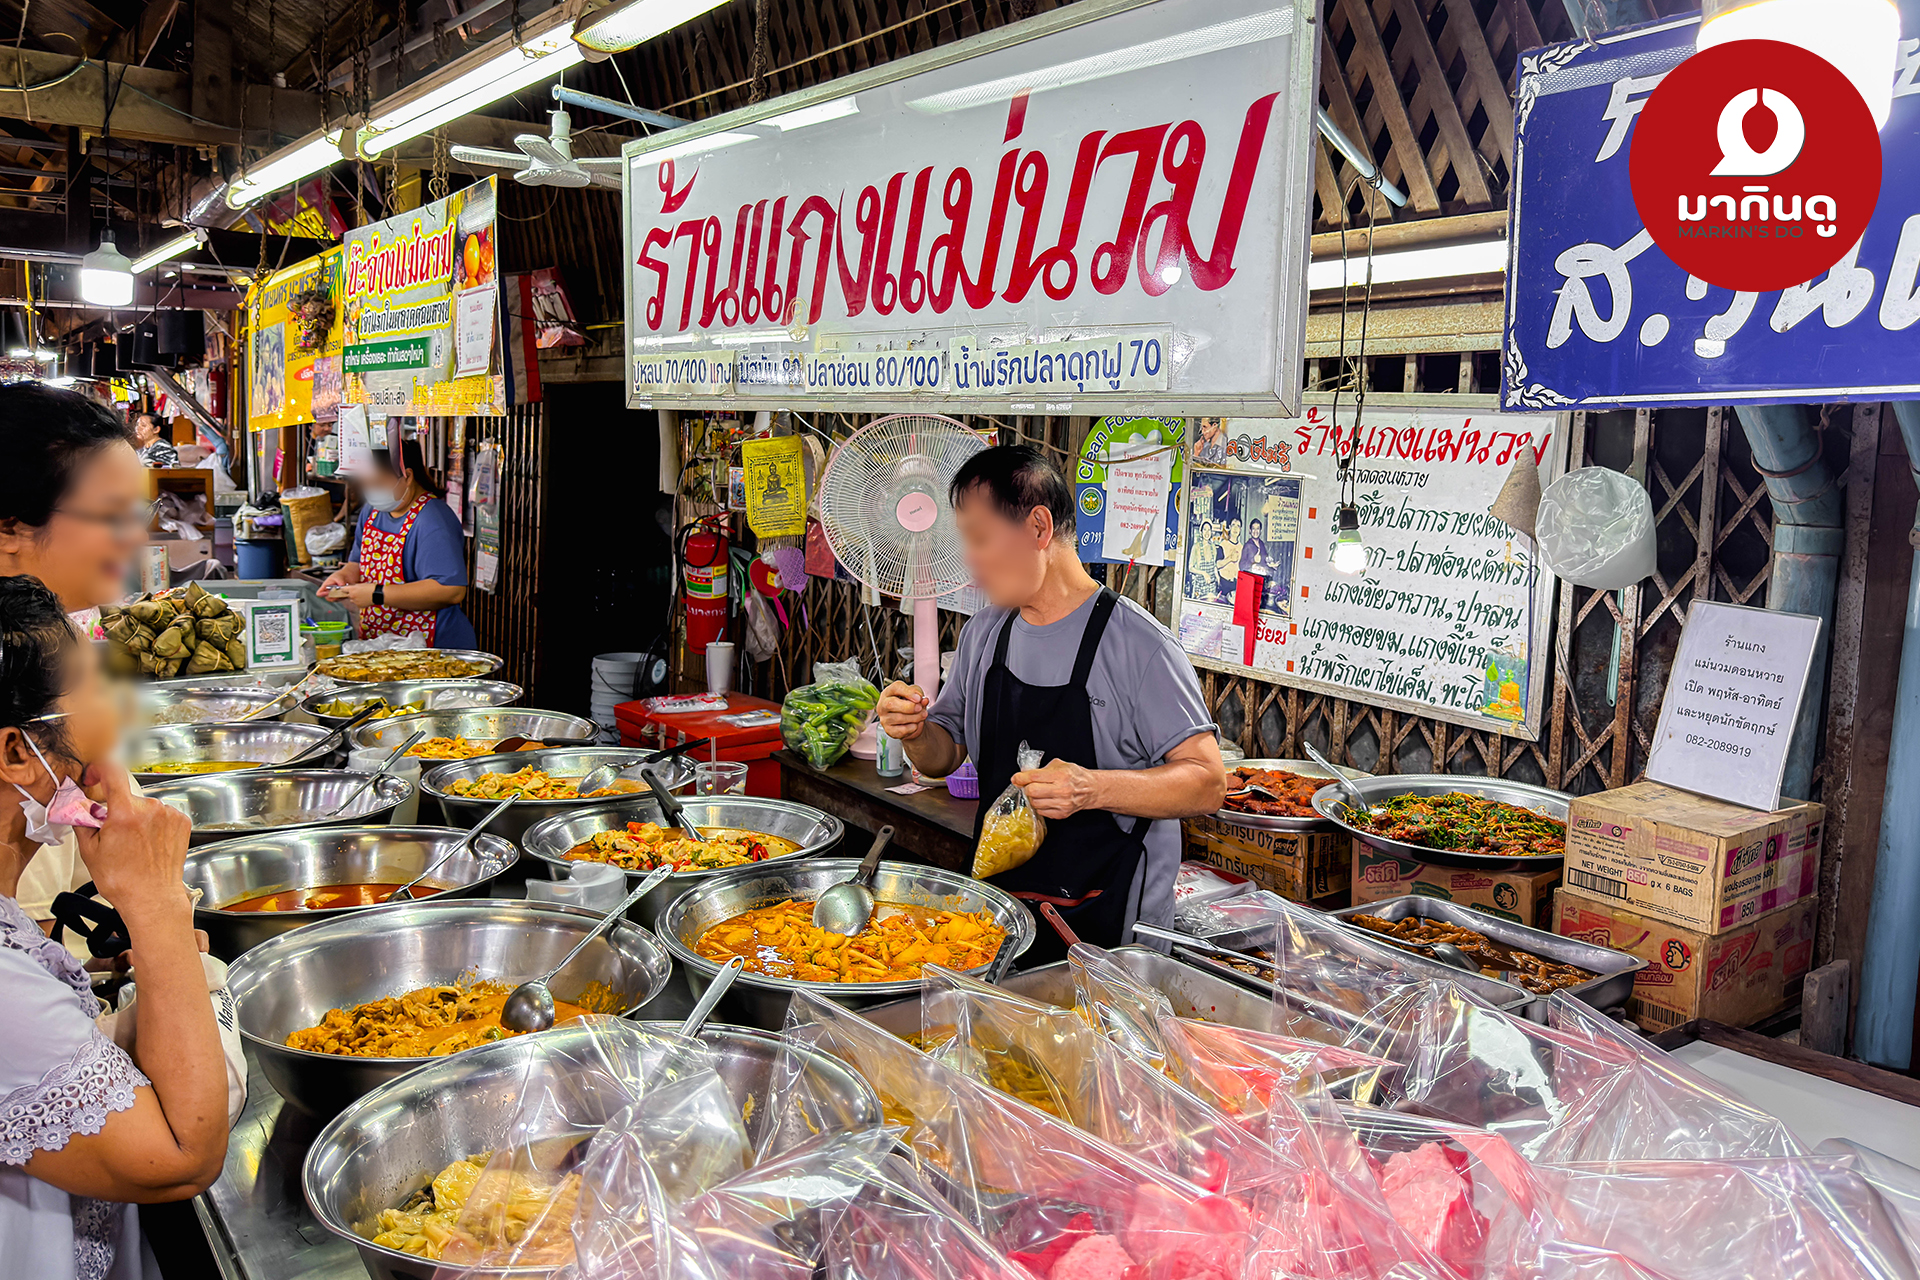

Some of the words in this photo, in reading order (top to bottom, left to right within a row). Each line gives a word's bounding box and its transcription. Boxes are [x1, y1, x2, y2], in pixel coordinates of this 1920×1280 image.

[637, 87, 1281, 331] ร้านแกงแม่นวม
[348, 224, 454, 296] บ๊ะจ่างแม่นวม
[665, 358, 706, 384] 70/100
[807, 356, 870, 387] ปลาช่อน
[875, 355, 940, 387] 80/100
[953, 340, 1123, 391] น้ำพริกปลาดุกฟู
[1130, 337, 1162, 379] 70
[1293, 407, 1552, 467] ร้านแกงแม่นวม
[1079, 430, 1108, 480] Clean
[1325, 577, 1523, 632] แกงเขียวหวาน,ปูหลน
[1724, 635, 1767, 653] ร้านแกง
[1694, 658, 1785, 684] แม่นวมดอนหวาย
[1684, 680, 1704, 694] เปิด
[1708, 686, 1784, 710] พฤหัส-อาทิตย์
[1676, 706, 1778, 736] และหยุดนักขัตฤกษ์
[1685, 734, 1752, 758] 082-2089919
[1209, 851, 1222, 867] 40
[1226, 856, 1249, 876] กรัม
[1366, 861, 1398, 883] รสดี
[1581, 860, 1594, 869] NET
[1597, 864, 1623, 878] WEIGHT
[1627, 869, 1647, 884] 850
[1665, 882, 1671, 891] 6
[1673, 885, 1693, 897] BAGS
[1742, 901, 1754, 918] 850
